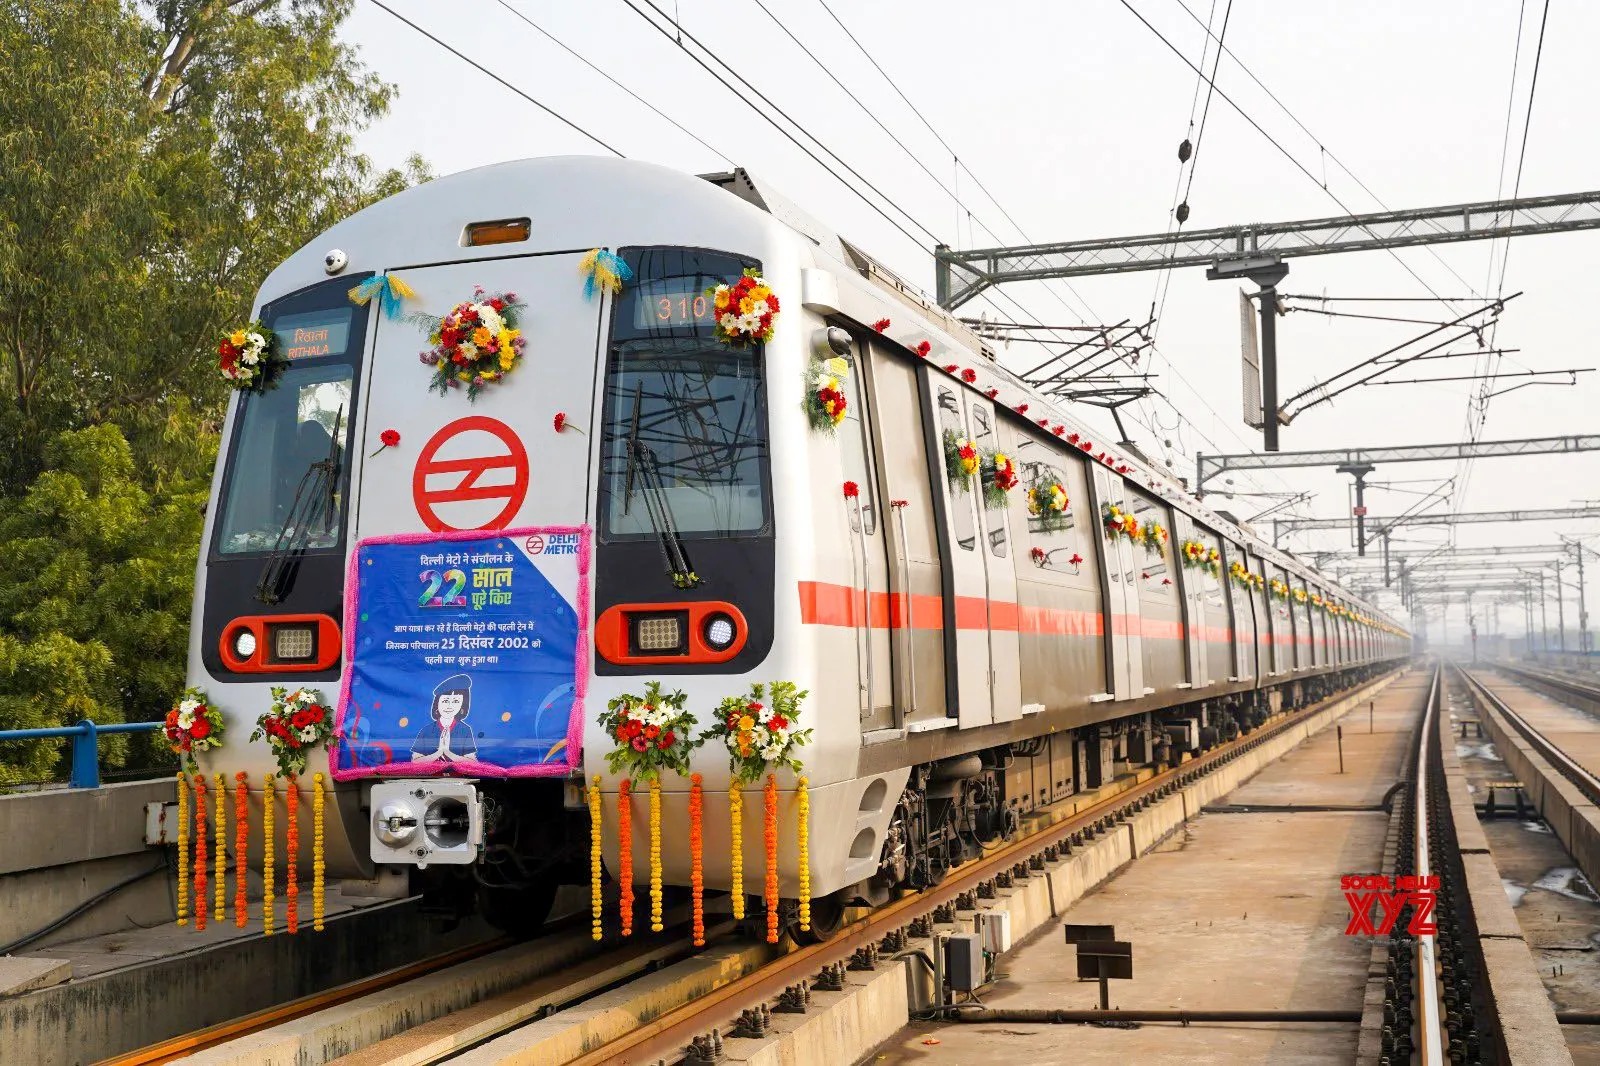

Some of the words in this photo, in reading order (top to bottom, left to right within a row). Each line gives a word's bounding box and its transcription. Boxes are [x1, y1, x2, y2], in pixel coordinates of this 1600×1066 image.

[657, 296, 705, 319] 310
[287, 344, 329, 359] RITHALA
[549, 534, 578, 544] DELHI
[420, 553, 444, 566] दिल्ली
[446, 553, 461, 567] मेट्रो
[463, 552, 469, 564] ने
[471, 552, 503, 564] संचालन
[504, 551, 514, 563] के
[418, 569, 467, 607] 22
[472, 568, 513, 588] साल
[471, 589, 487, 611] पूरे
[488, 589, 512, 605] किए
[394, 624, 407, 632] आप
[408, 624, 423, 632] यात्रा
[424, 624, 435, 632] कर
[436, 622, 445, 632] रहे
[452, 621, 472, 632] दिल्ली
[473, 621, 486, 633] मेट्रो
[487, 621, 496, 631] की
[498, 621, 516, 632] पहली
[517, 621, 527, 633] ट्रेन
[385, 640, 408, 650] जिसका
[410, 640, 439, 650] परिचालन
[441, 638, 455, 649] 25
[458, 634, 495, 650] दिसंबर
[497, 637, 529, 649] 2002
[531, 638, 542, 648] को
[425, 654, 443, 665] पहली
[472, 656, 486, 667] हुआ
